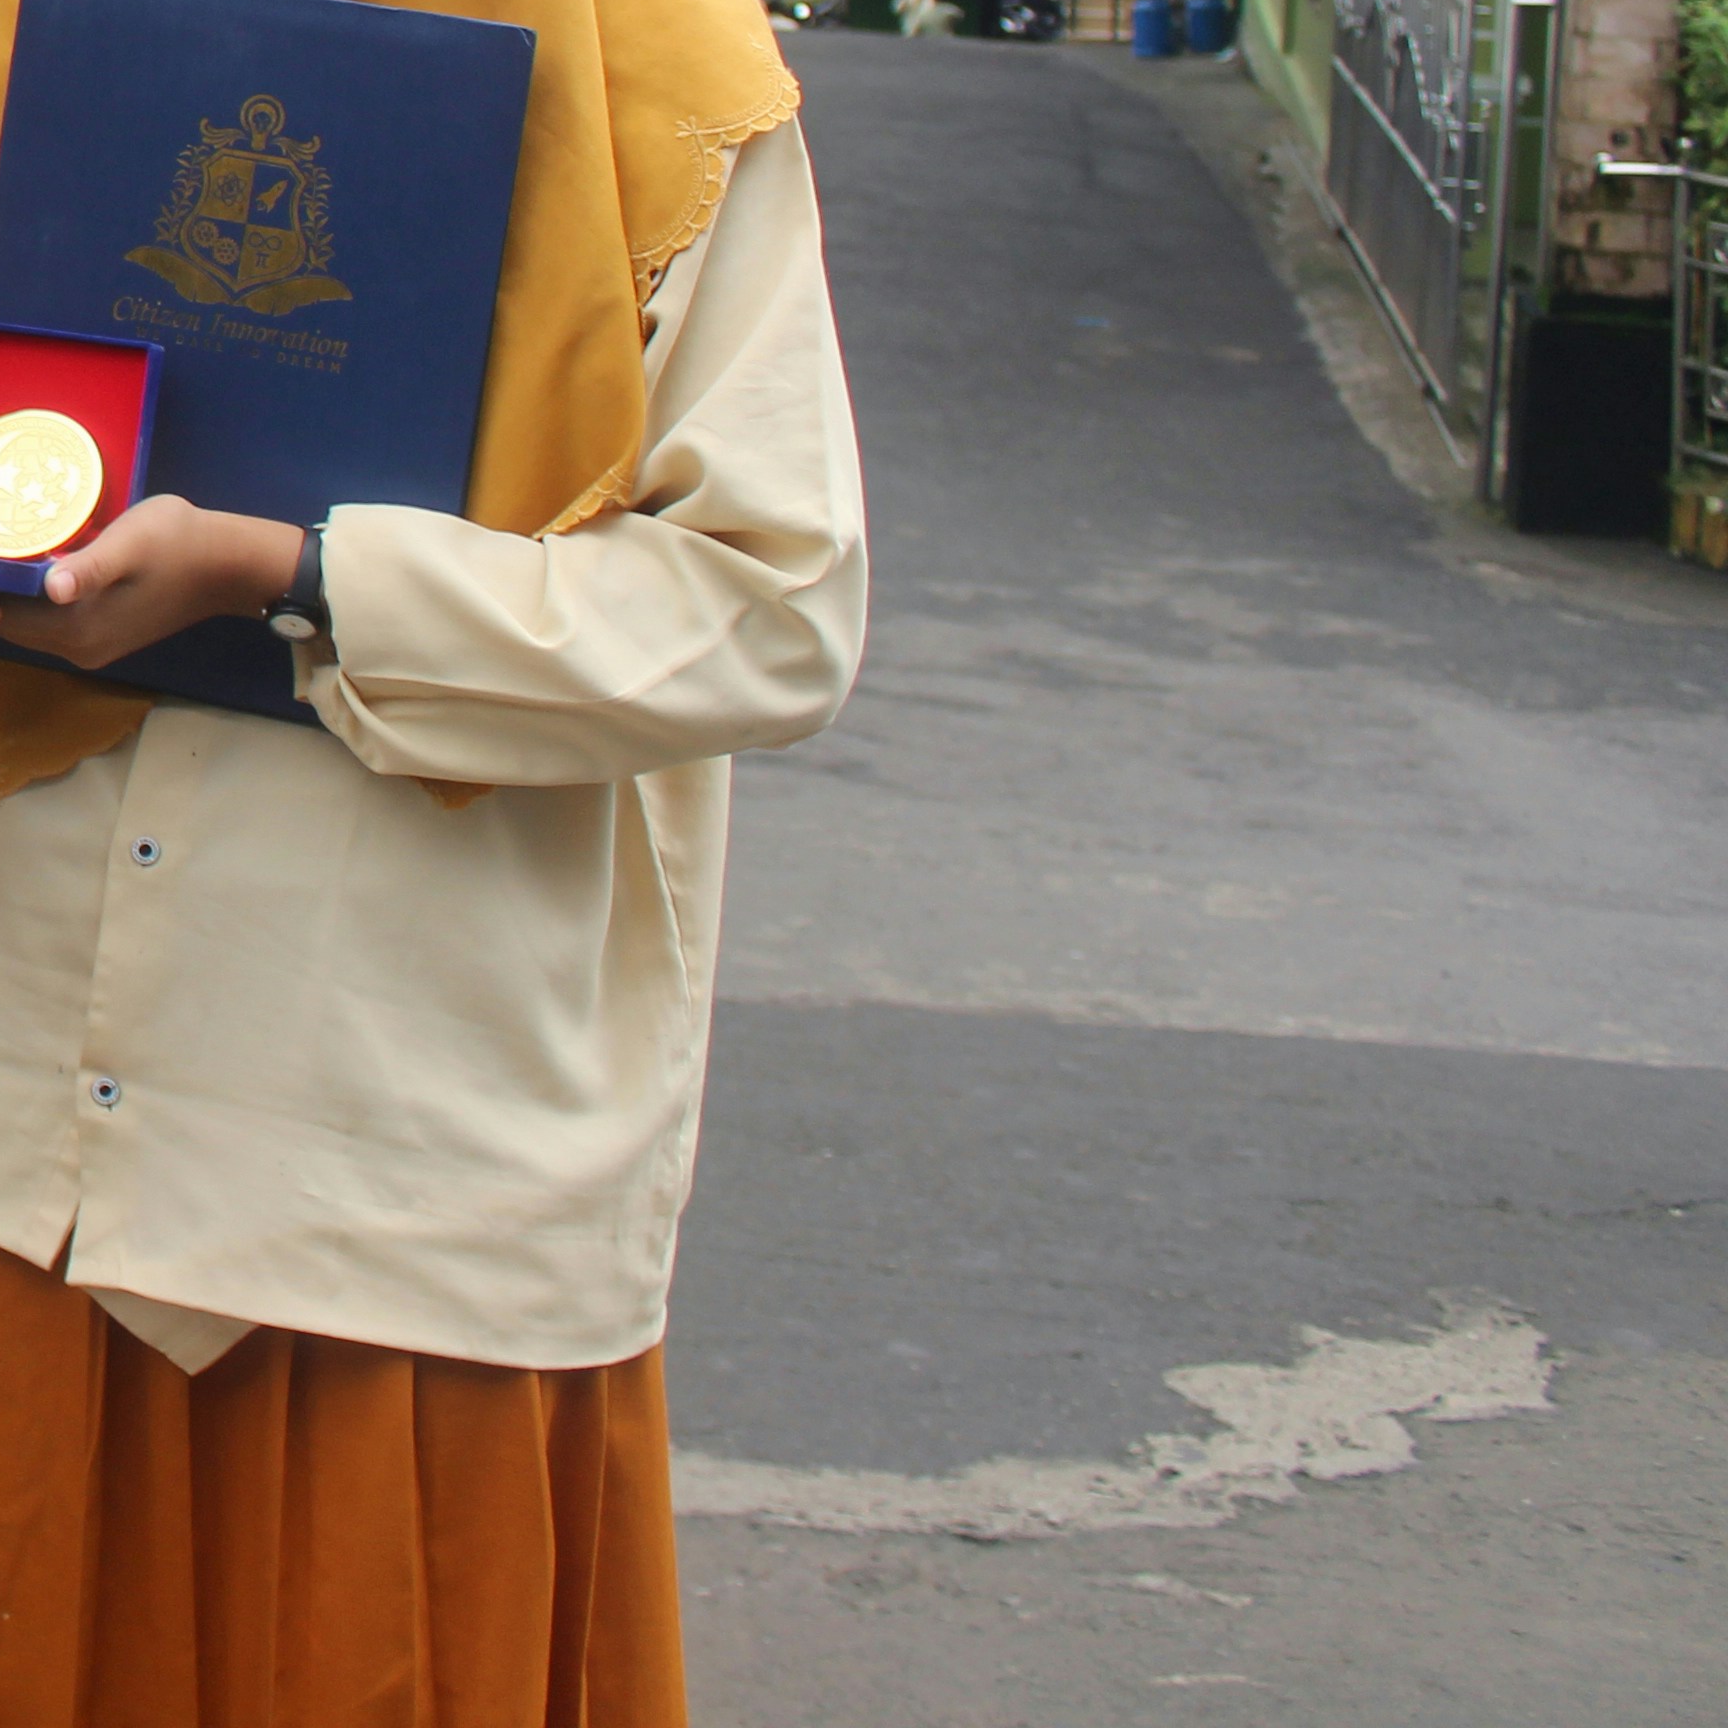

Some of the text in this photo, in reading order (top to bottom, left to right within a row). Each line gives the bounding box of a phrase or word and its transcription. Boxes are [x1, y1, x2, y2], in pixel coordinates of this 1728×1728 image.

[112, 296, 349, 358] Citizen Innovation
[277, 352, 341, 374] DREAM
